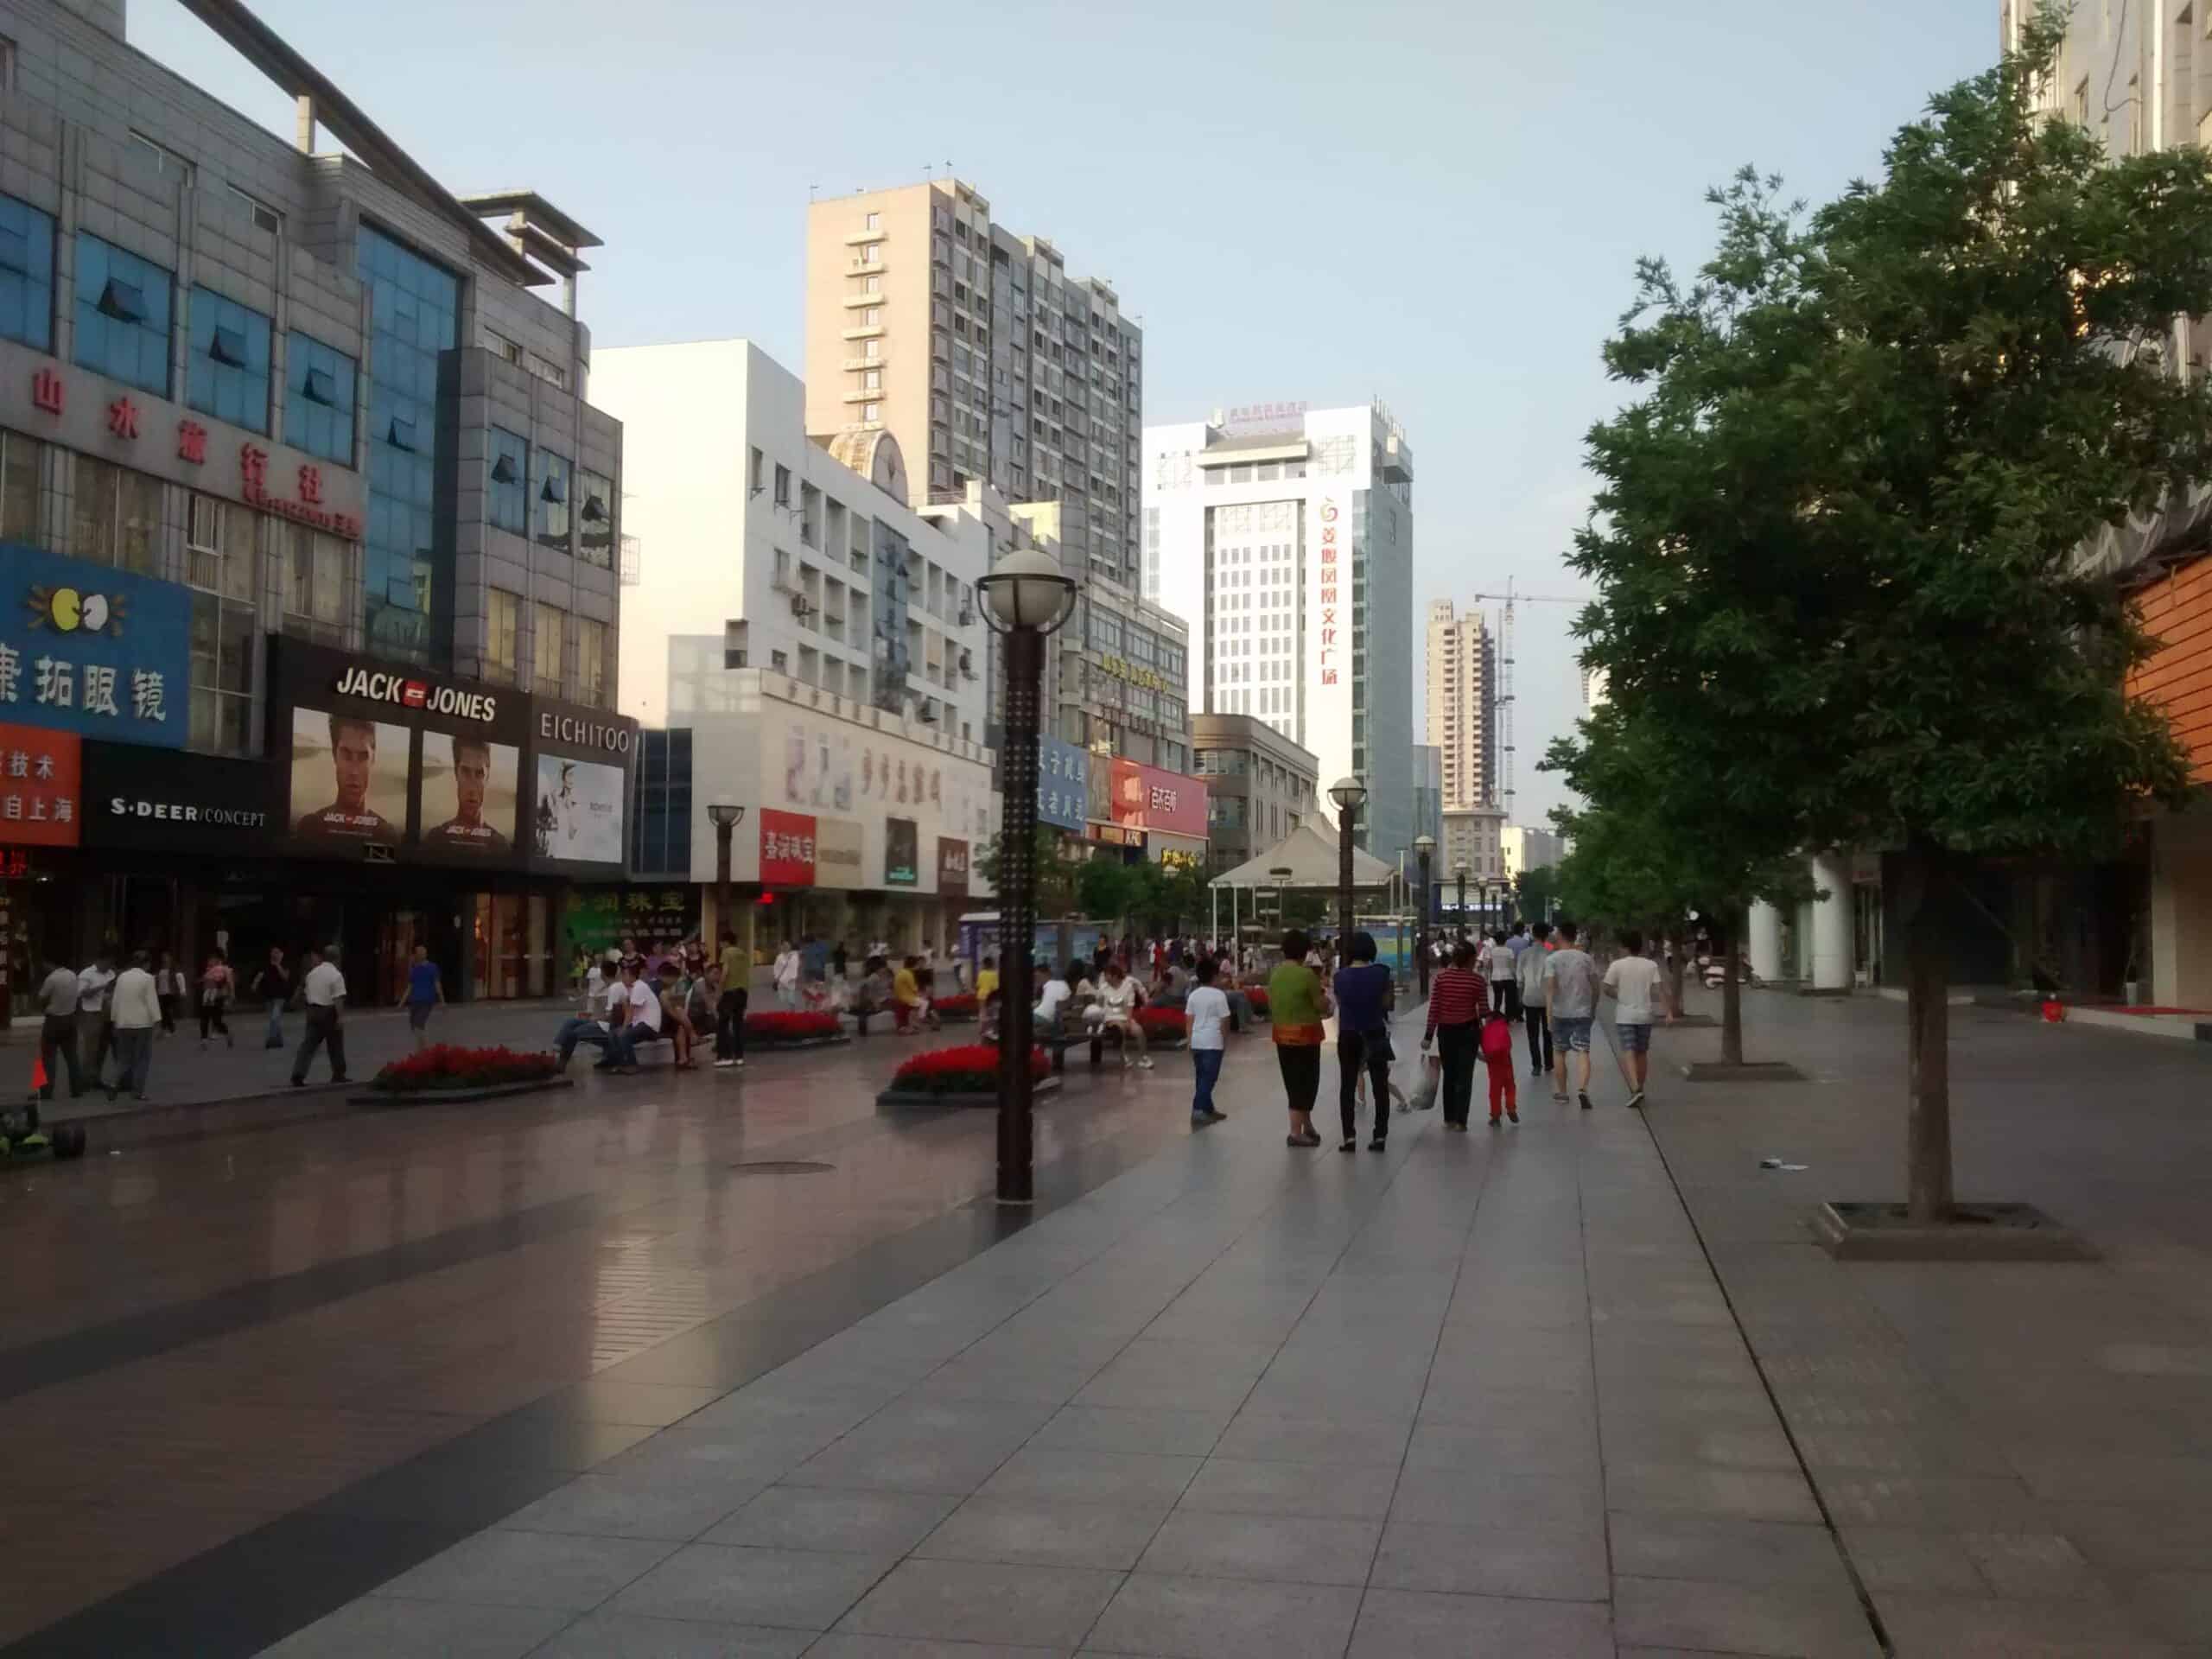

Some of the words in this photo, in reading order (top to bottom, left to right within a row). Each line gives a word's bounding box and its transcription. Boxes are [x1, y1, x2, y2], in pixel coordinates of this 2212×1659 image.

[337, 667, 404, 703] JACK
[427, 688, 497, 722] JONES
[541, 712, 630, 753] EICHITOO
[0, 750, 54, 779] 技术
